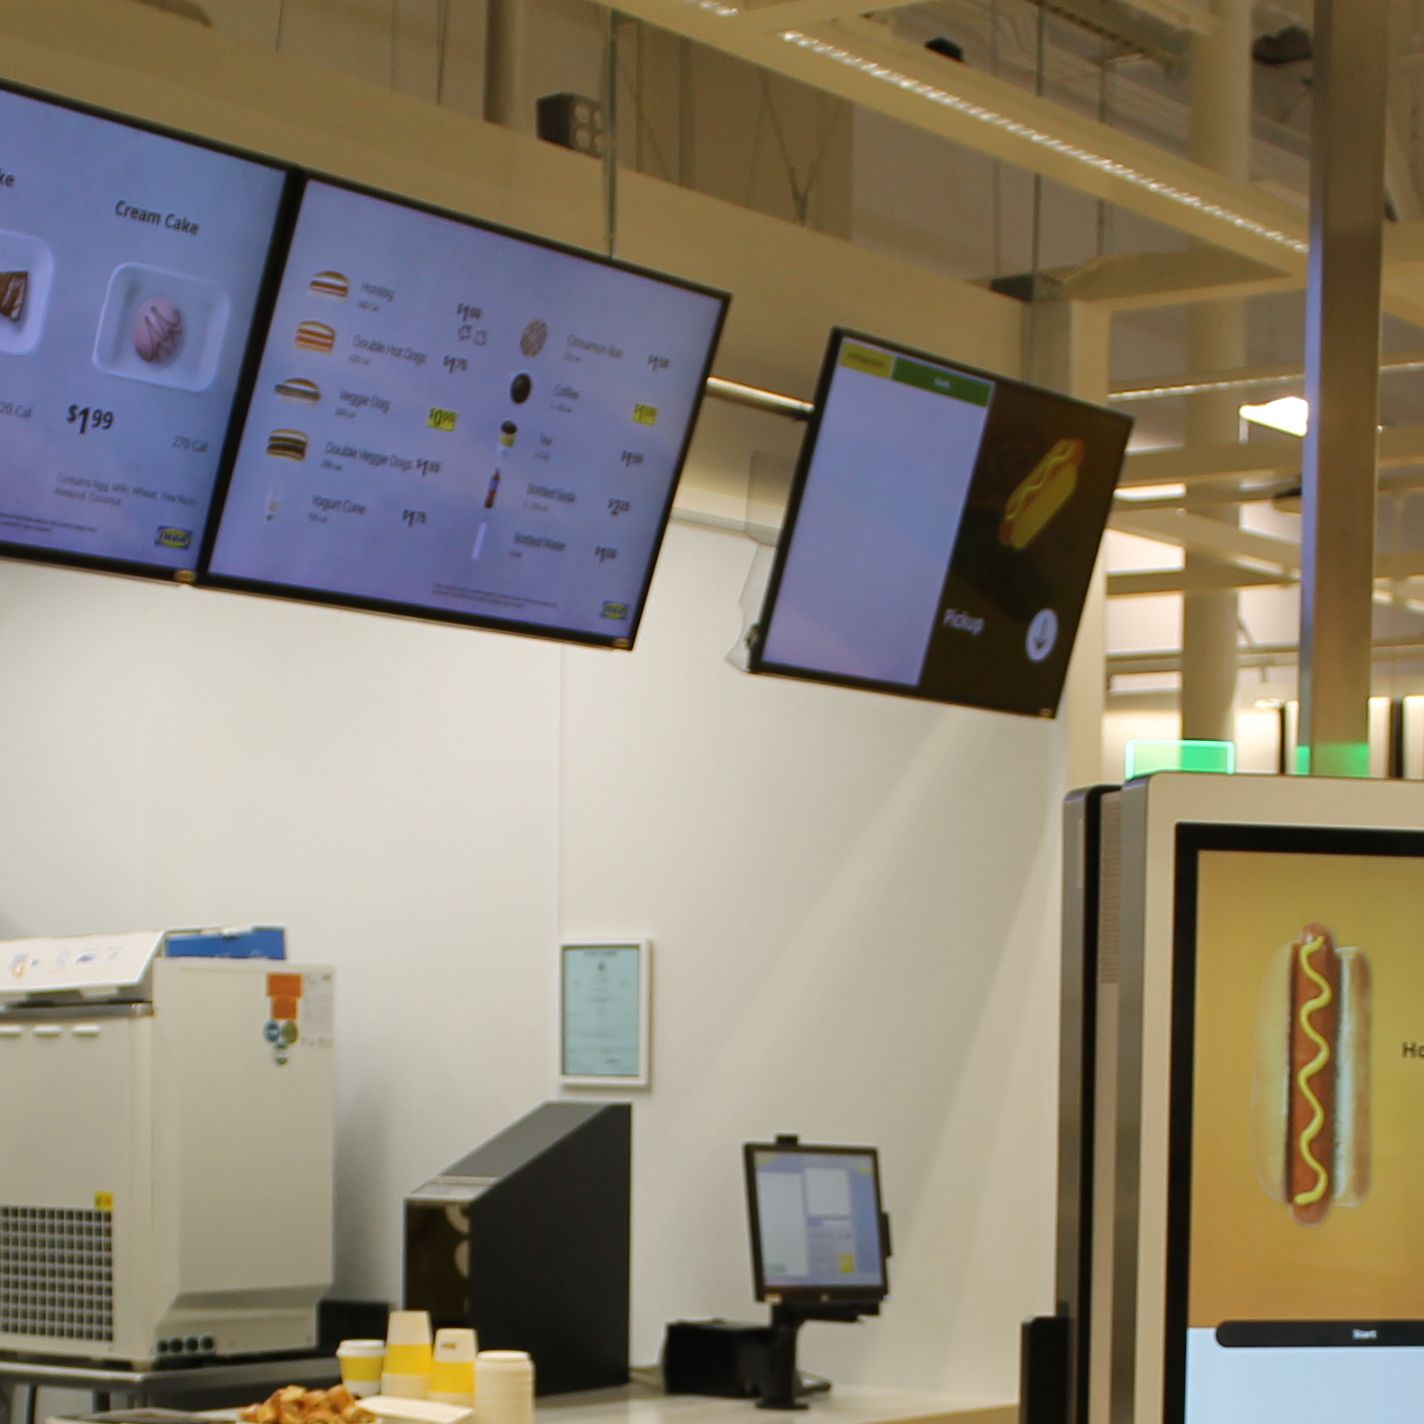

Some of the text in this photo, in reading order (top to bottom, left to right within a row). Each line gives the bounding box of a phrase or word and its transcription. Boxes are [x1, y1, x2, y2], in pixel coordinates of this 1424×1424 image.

[115, 200, 200, 237] Cream Cake
[14, 404, 32, 420] Cal
[943, 608, 984, 635] Pickup
